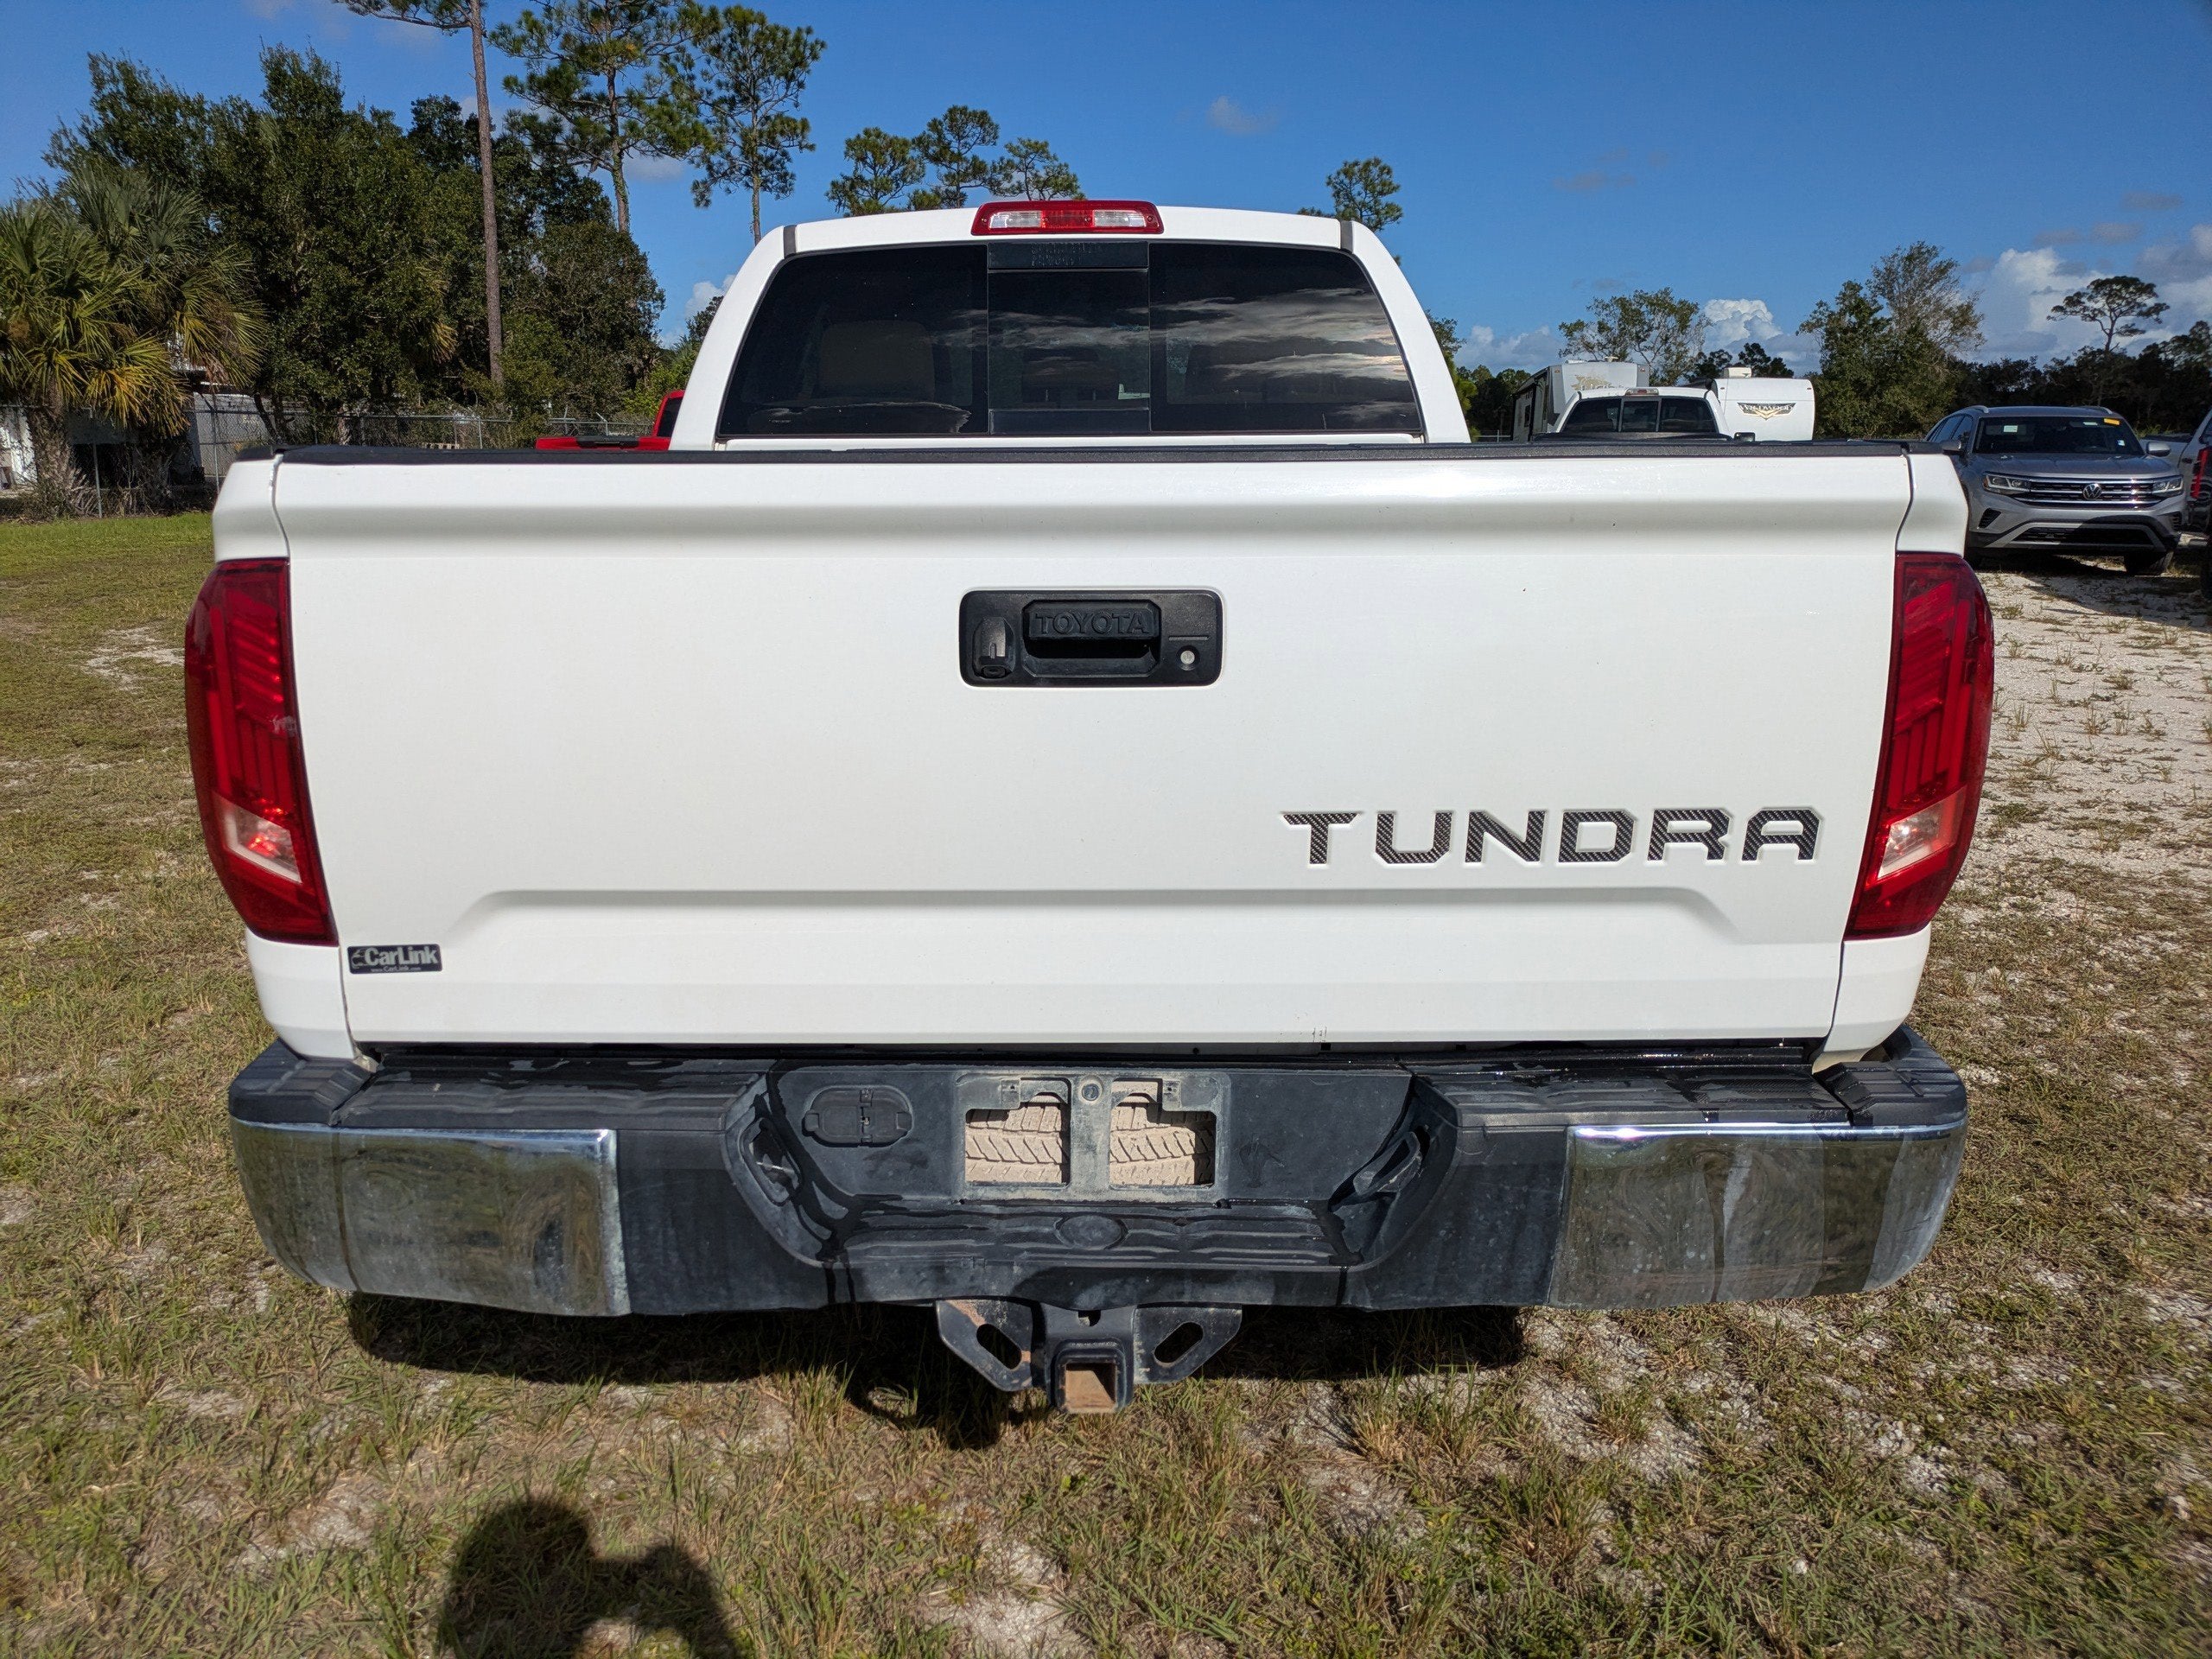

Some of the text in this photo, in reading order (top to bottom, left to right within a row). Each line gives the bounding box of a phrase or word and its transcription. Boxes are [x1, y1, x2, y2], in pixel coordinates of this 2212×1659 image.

[1035, 610, 1150, 635] TOYOTA
[1281, 808, 1821, 865] TUNDRA
[364, 945, 439, 966] CarLink
